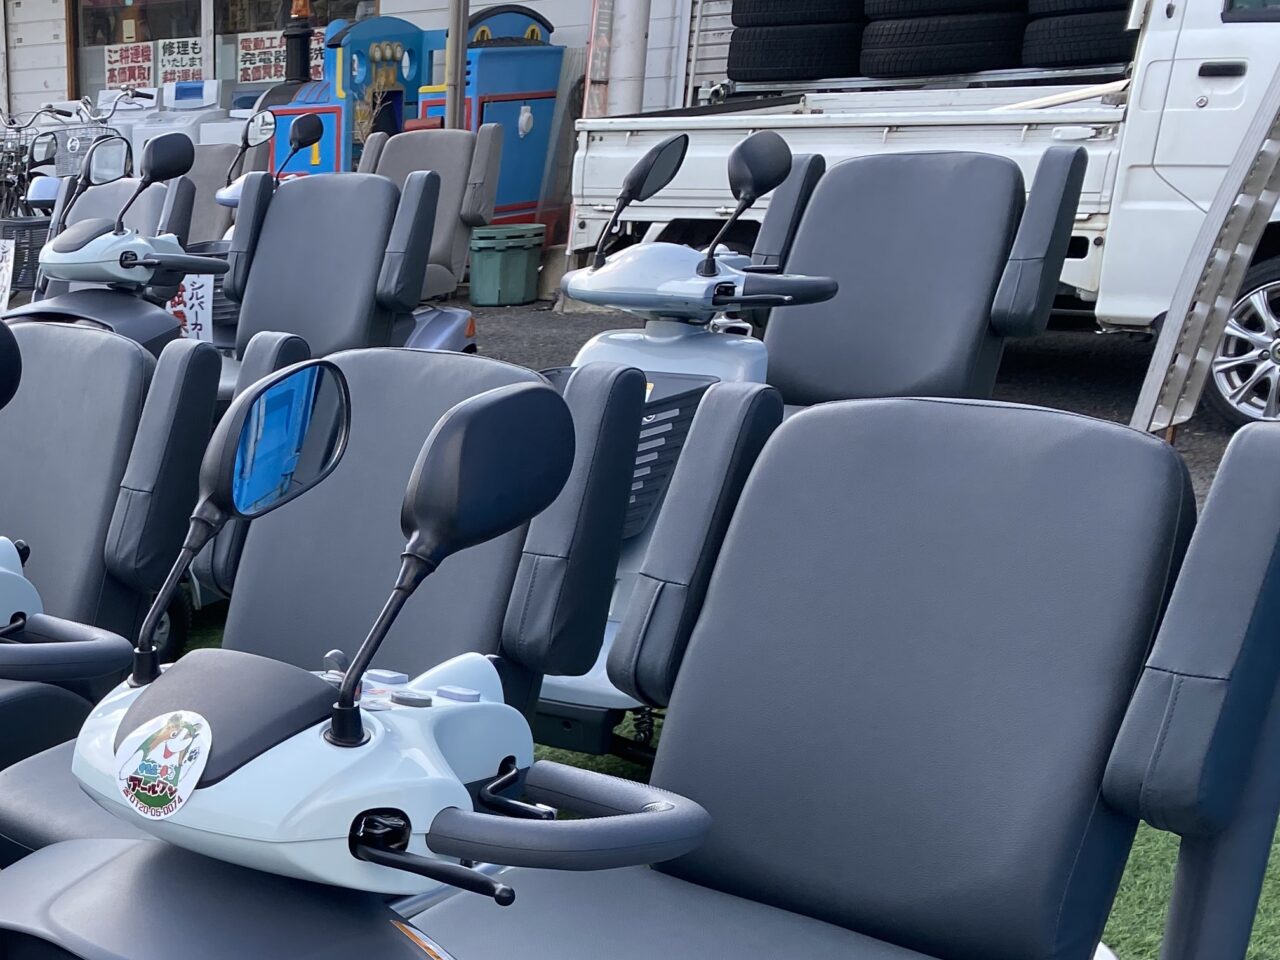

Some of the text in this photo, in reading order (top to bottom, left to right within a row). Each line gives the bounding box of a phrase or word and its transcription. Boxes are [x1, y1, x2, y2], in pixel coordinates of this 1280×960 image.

[189, 281, 205, 340] シルバーカー
[128, 775, 178, 798] アールワン
